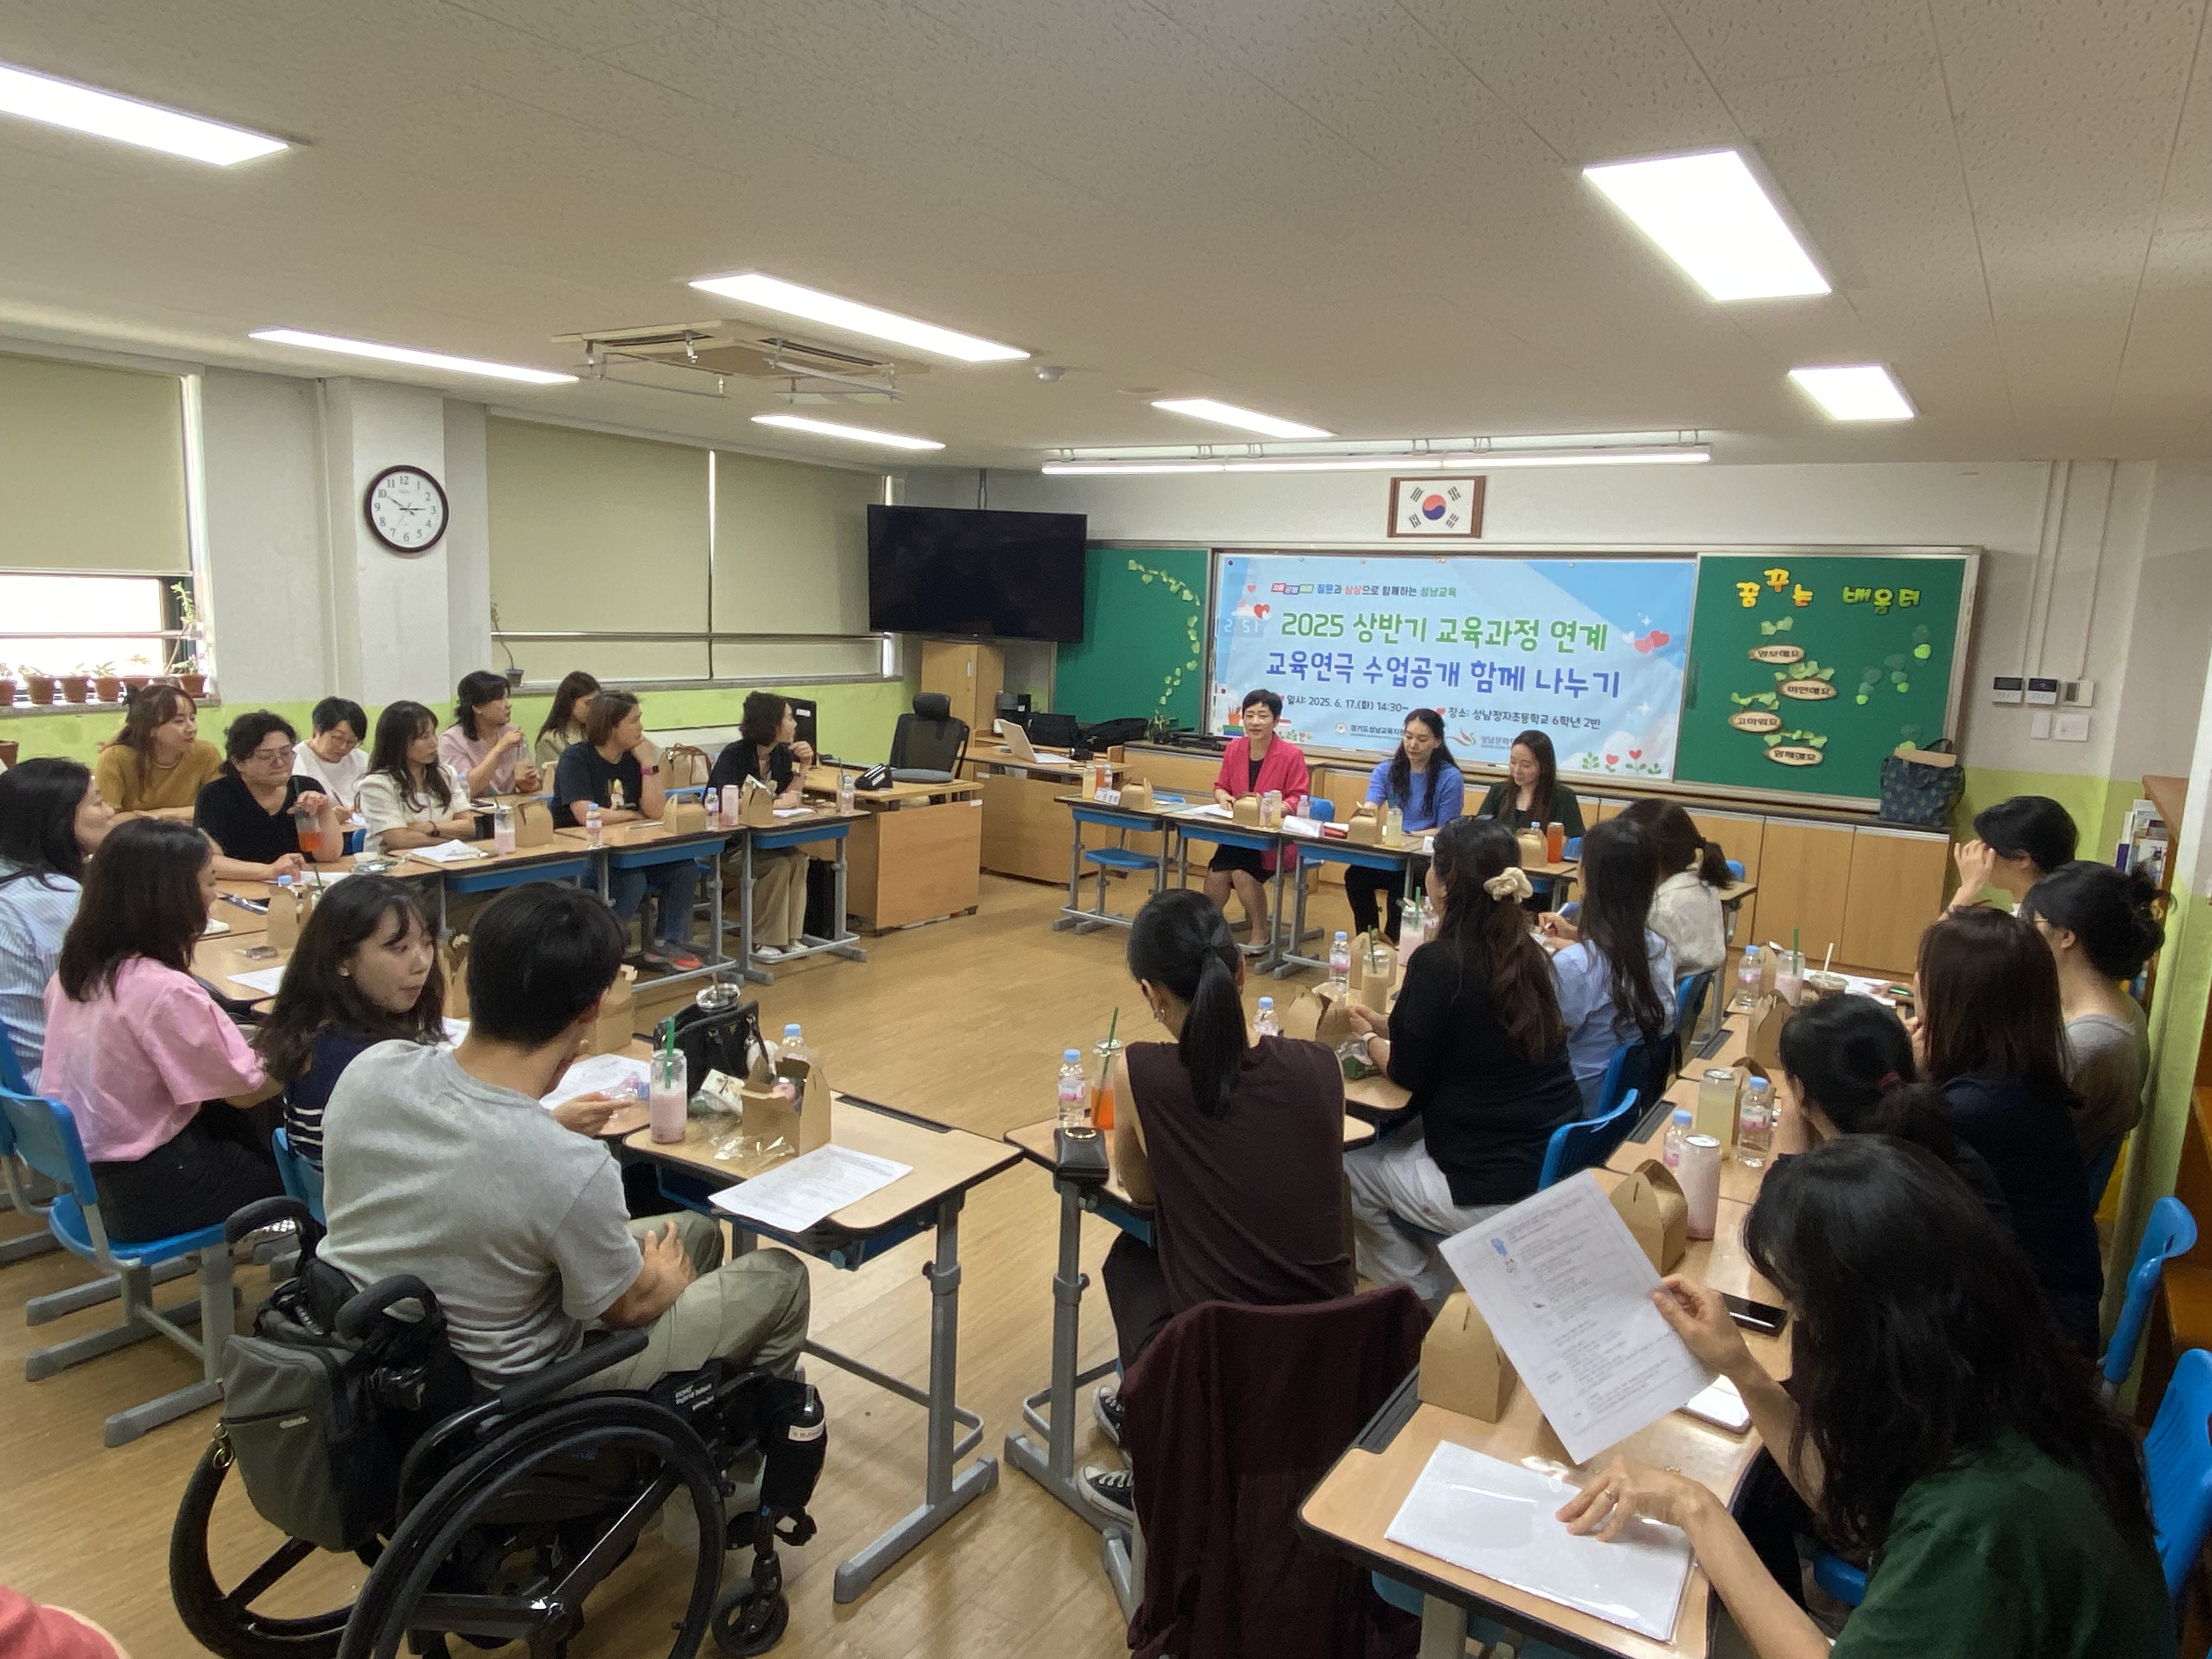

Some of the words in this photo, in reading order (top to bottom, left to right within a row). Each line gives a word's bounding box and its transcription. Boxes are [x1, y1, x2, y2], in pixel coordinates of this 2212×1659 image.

[387, 479, 396, 488] 11
[399, 476, 409, 485] 12
[417, 481, 420, 490] 1
[378, 489, 387, 498] 10
[425, 492, 431, 501] 2
[374, 503, 380, 512] 9
[430, 505, 436, 515] 3
[380, 517, 386, 527] 8
[426, 520, 431, 528] 4
[390, 528, 396, 538] 7
[403, 533, 410, 542] 6
[417, 529, 422, 538] 5
[1317, 583, 1342, 595] 질문과
[1345, 584, 1379, 596] 상상으로
[1383, 585, 1418, 597] 함께하는
[1421, 586, 1457, 598] 성남교육
[1736, 568, 1813, 608] 꿈꾸는
[1843, 586, 1920, 615] 배움터
[1281, 612, 1344, 637] 2025
[1353, 613, 1427, 644] 상반기
[1435, 616, 1540, 652] 교육과정
[1551, 620, 1608, 653] 연계
[1266, 650, 1355, 684] 교육연극
[1363, 656, 1460, 689] 수업공개
[1471, 660, 1526, 693] 함께
[1536, 668, 1620, 698] 나누기
[1287, 695, 1306, 706] 일시:
[1308, 696, 1331, 707] 2025.
[1334, 698, 1342, 708] 6.
[1345, 699, 1374, 710] 17.(화)
[1377, 702, 1409, 712] 14:30~
[1449, 707, 1470, 719] 장소:
[1472, 708, 1549, 725] 성남정자초등학교
[1552, 715, 1581, 729] 6학년
[1584, 717, 1601, 730] 2반
[1737, 718, 1778, 726] 고마워요
